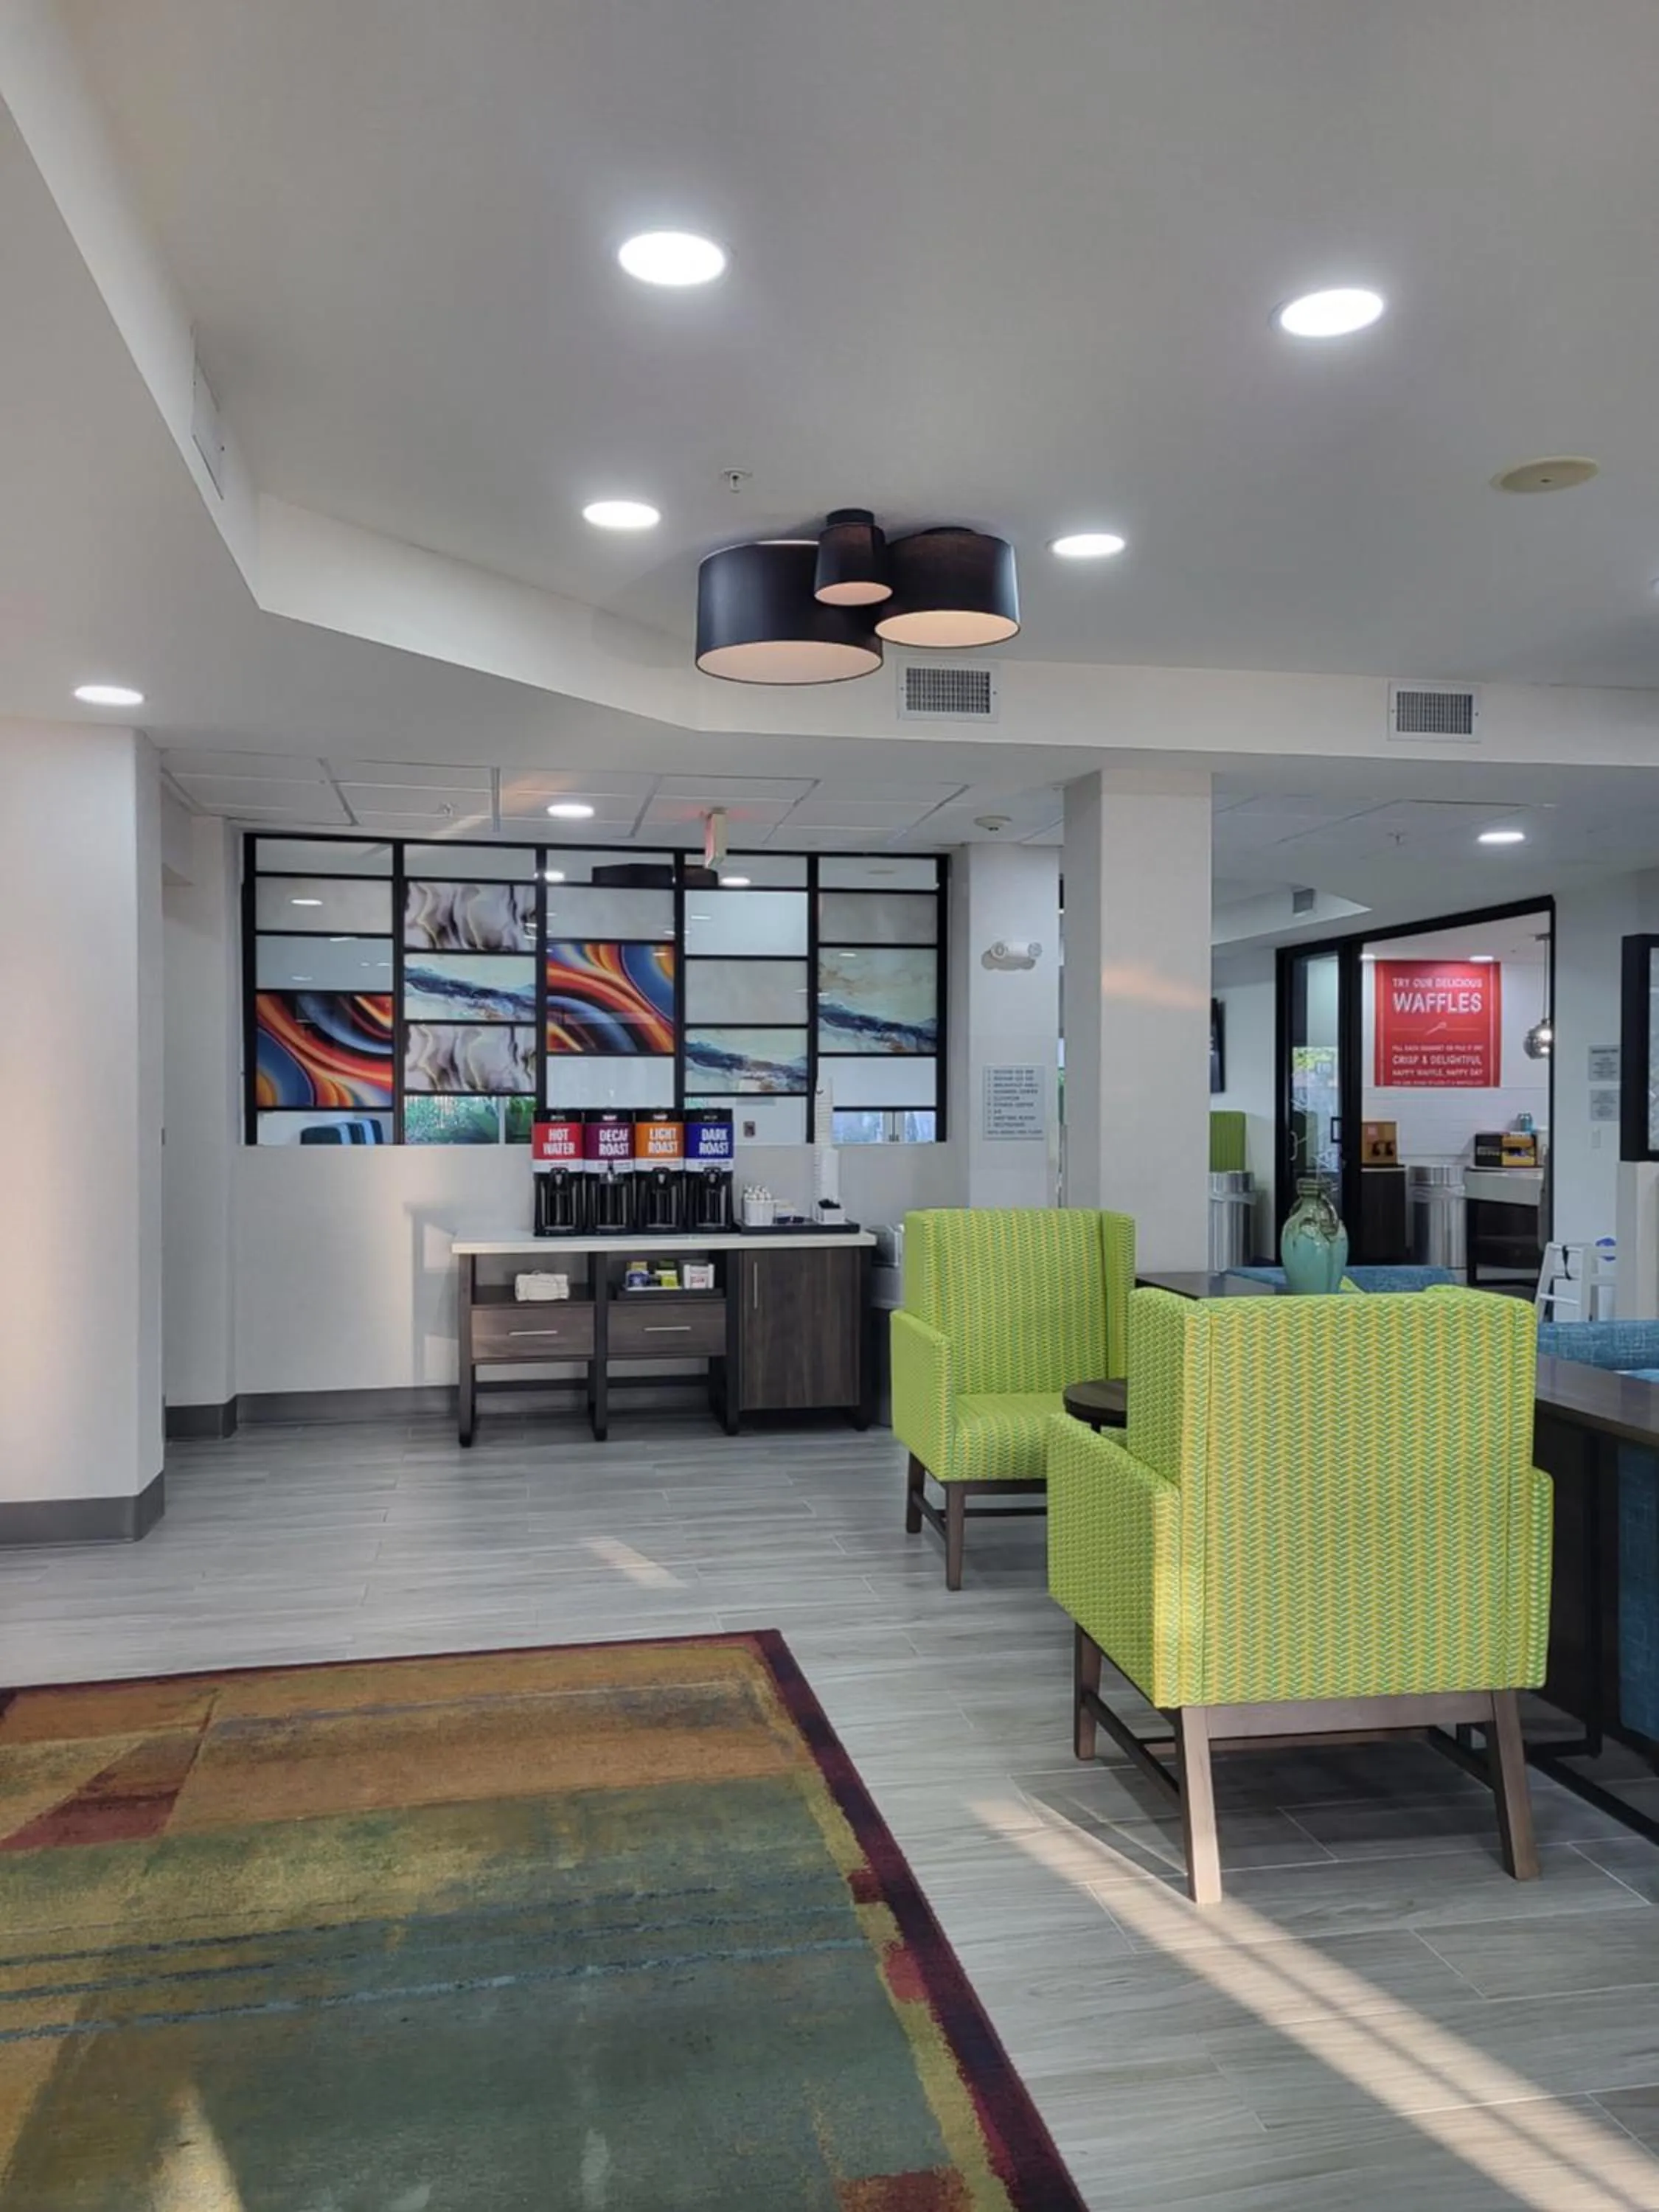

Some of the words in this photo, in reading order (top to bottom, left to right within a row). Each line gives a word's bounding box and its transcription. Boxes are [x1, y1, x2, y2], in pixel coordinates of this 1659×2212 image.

[1392, 978, 1410, 988] TRY
[1413, 978, 1433, 989] OUR
[1435, 978, 1483, 989] DELICIOUS
[1392, 992, 1483, 1014] WAFFLES
[1392, 1054, 1420, 1065] CRISP
[1422, 1054, 1428, 1065] &
[1430, 1054, 1483, 1065] DELIGHTFUL
[548, 1127, 568, 1141] HOT
[599, 1129, 629, 1142] DECAF
[650, 1127, 676, 1141] LIGHT
[701, 1128, 728, 1141] DARK
[543, 1141, 575, 1155] WATER
[599, 1142, 629, 1156] ROAST
[648, 1141, 678, 1155] ROAST
[699, 1141, 729, 1155] ROAST
